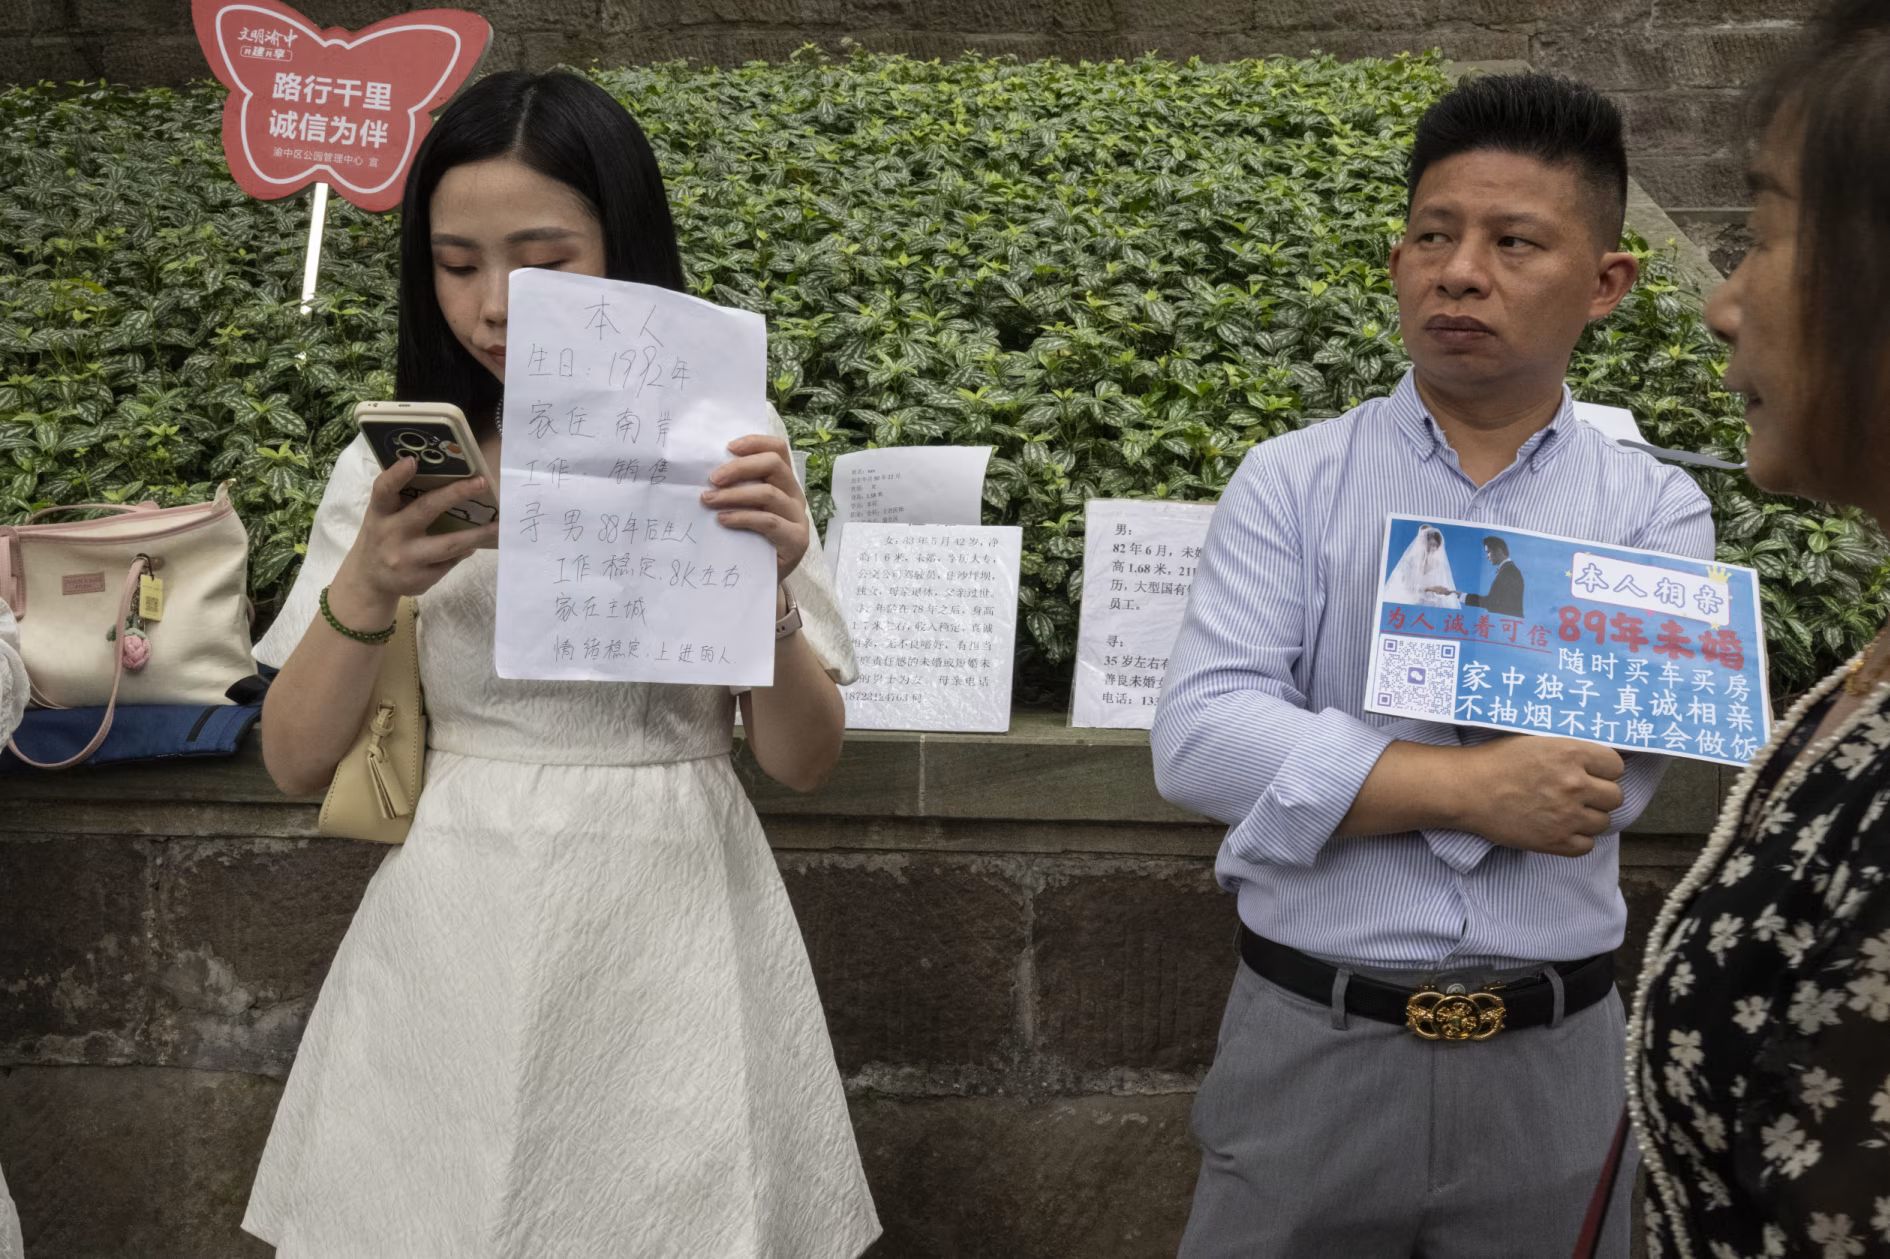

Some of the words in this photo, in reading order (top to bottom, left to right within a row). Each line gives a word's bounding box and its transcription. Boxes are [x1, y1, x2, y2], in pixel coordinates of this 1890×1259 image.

[272, 72, 392, 111] 路行千里
[268, 109, 388, 149] 诚信为伴
[273, 147, 363, 166] 渝中区公园管理中心
[584, 295, 664, 347] 本人
[1110, 578, 1192, 596] 历，大型国有
[1574, 563, 1724, 615] 本人相亲
[1558, 605, 1745, 671] 89年未婚
[1559, 647, 1751, 702] 随时买车买房
[1454, 695, 1758, 761] 不抽烟不打牌会做饭
